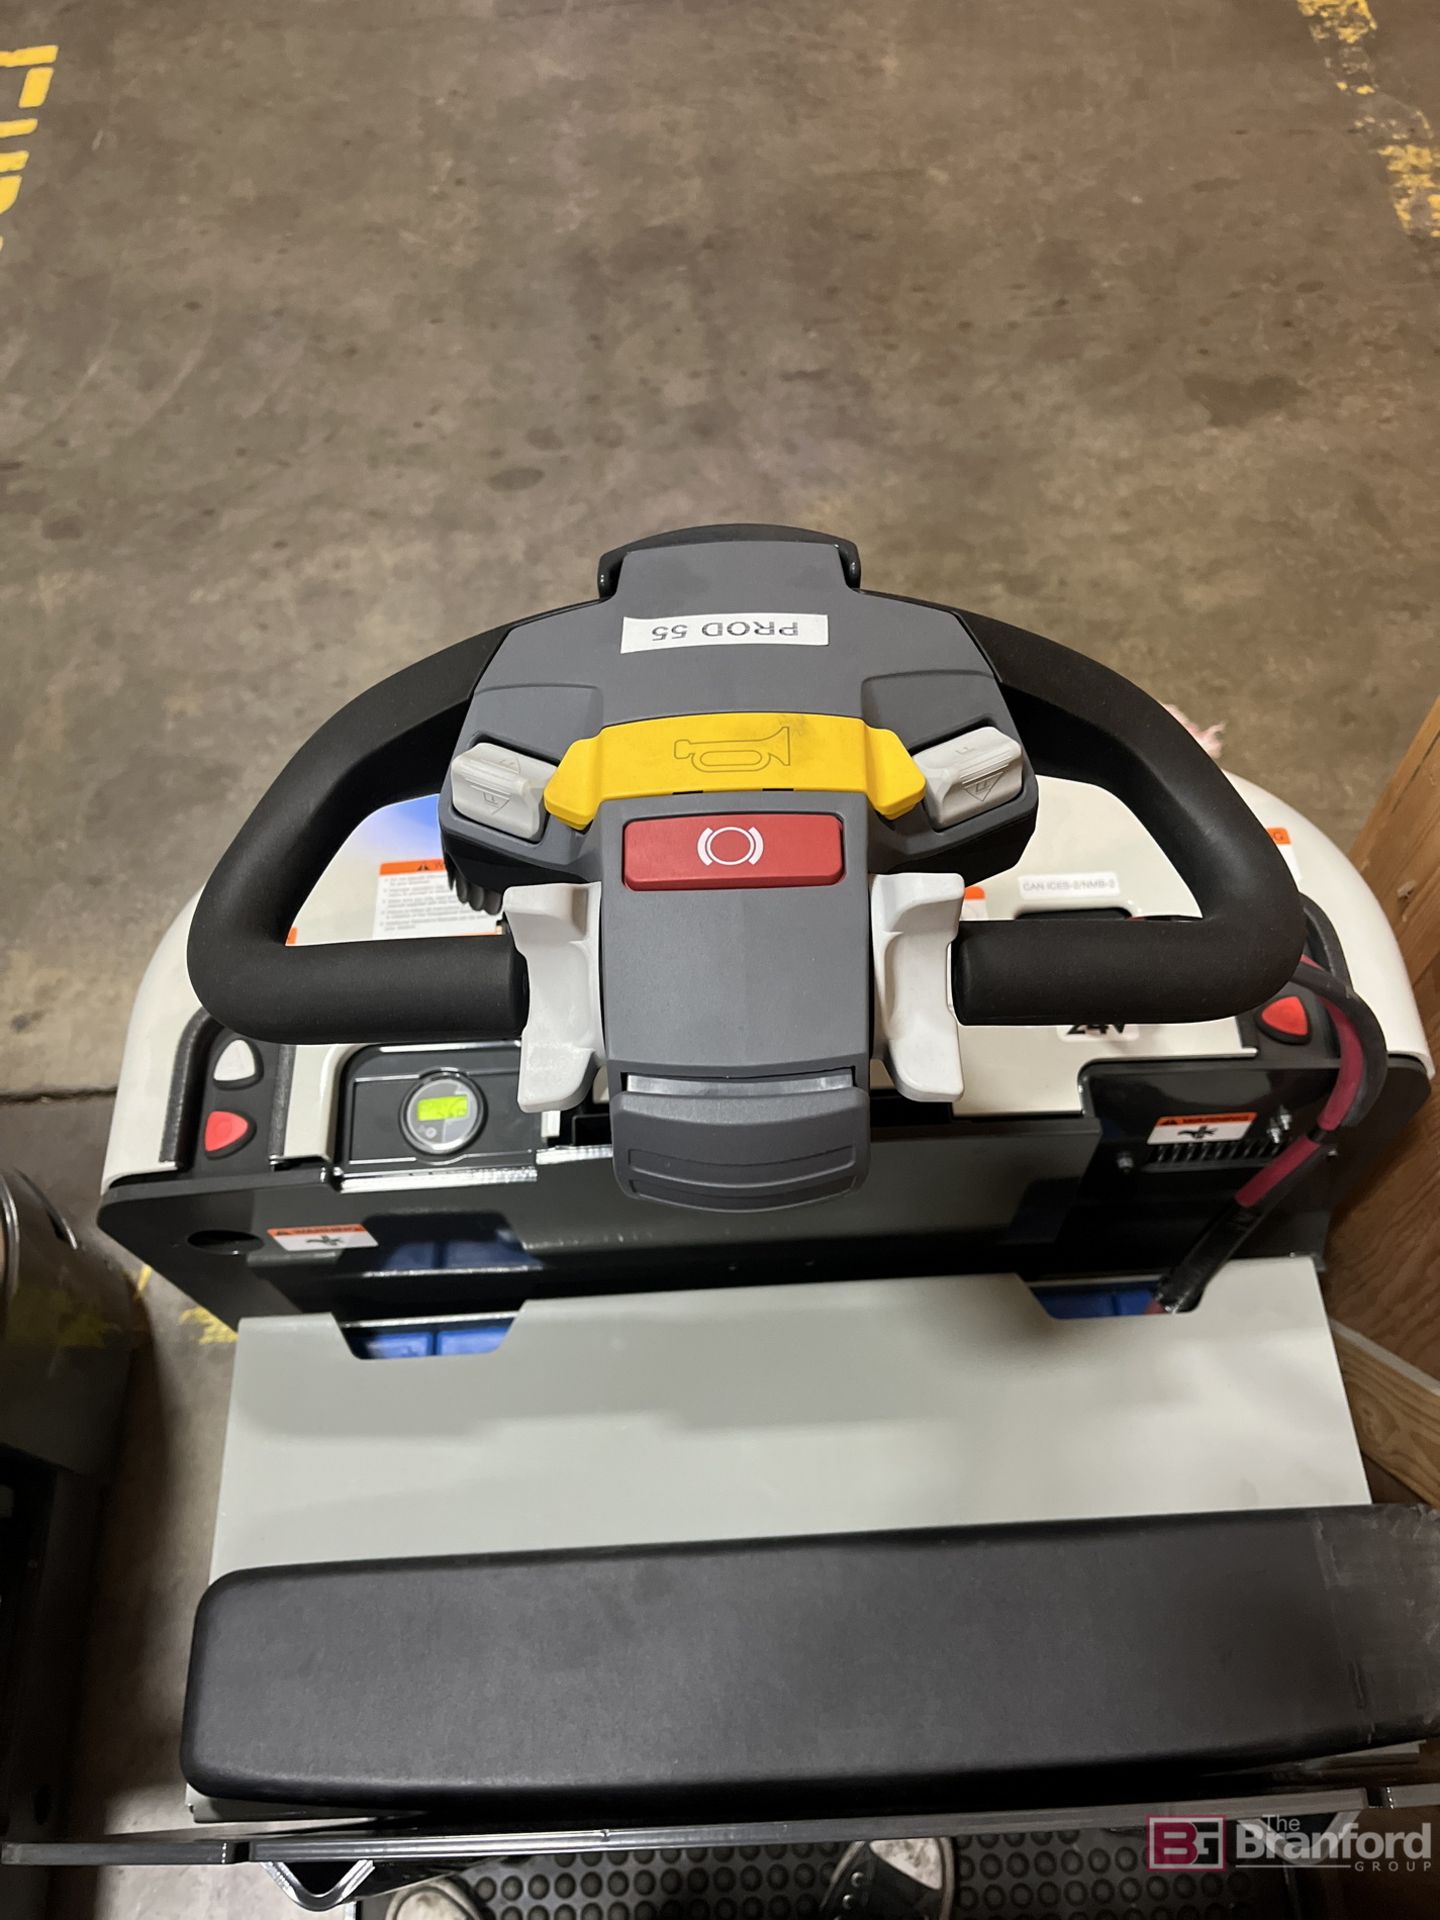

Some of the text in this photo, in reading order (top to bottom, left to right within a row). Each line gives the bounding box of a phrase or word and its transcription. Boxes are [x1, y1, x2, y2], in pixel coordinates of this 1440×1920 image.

[651, 621, 799, 642] PROD 55
[1022, 881, 1045, 892] CAN
